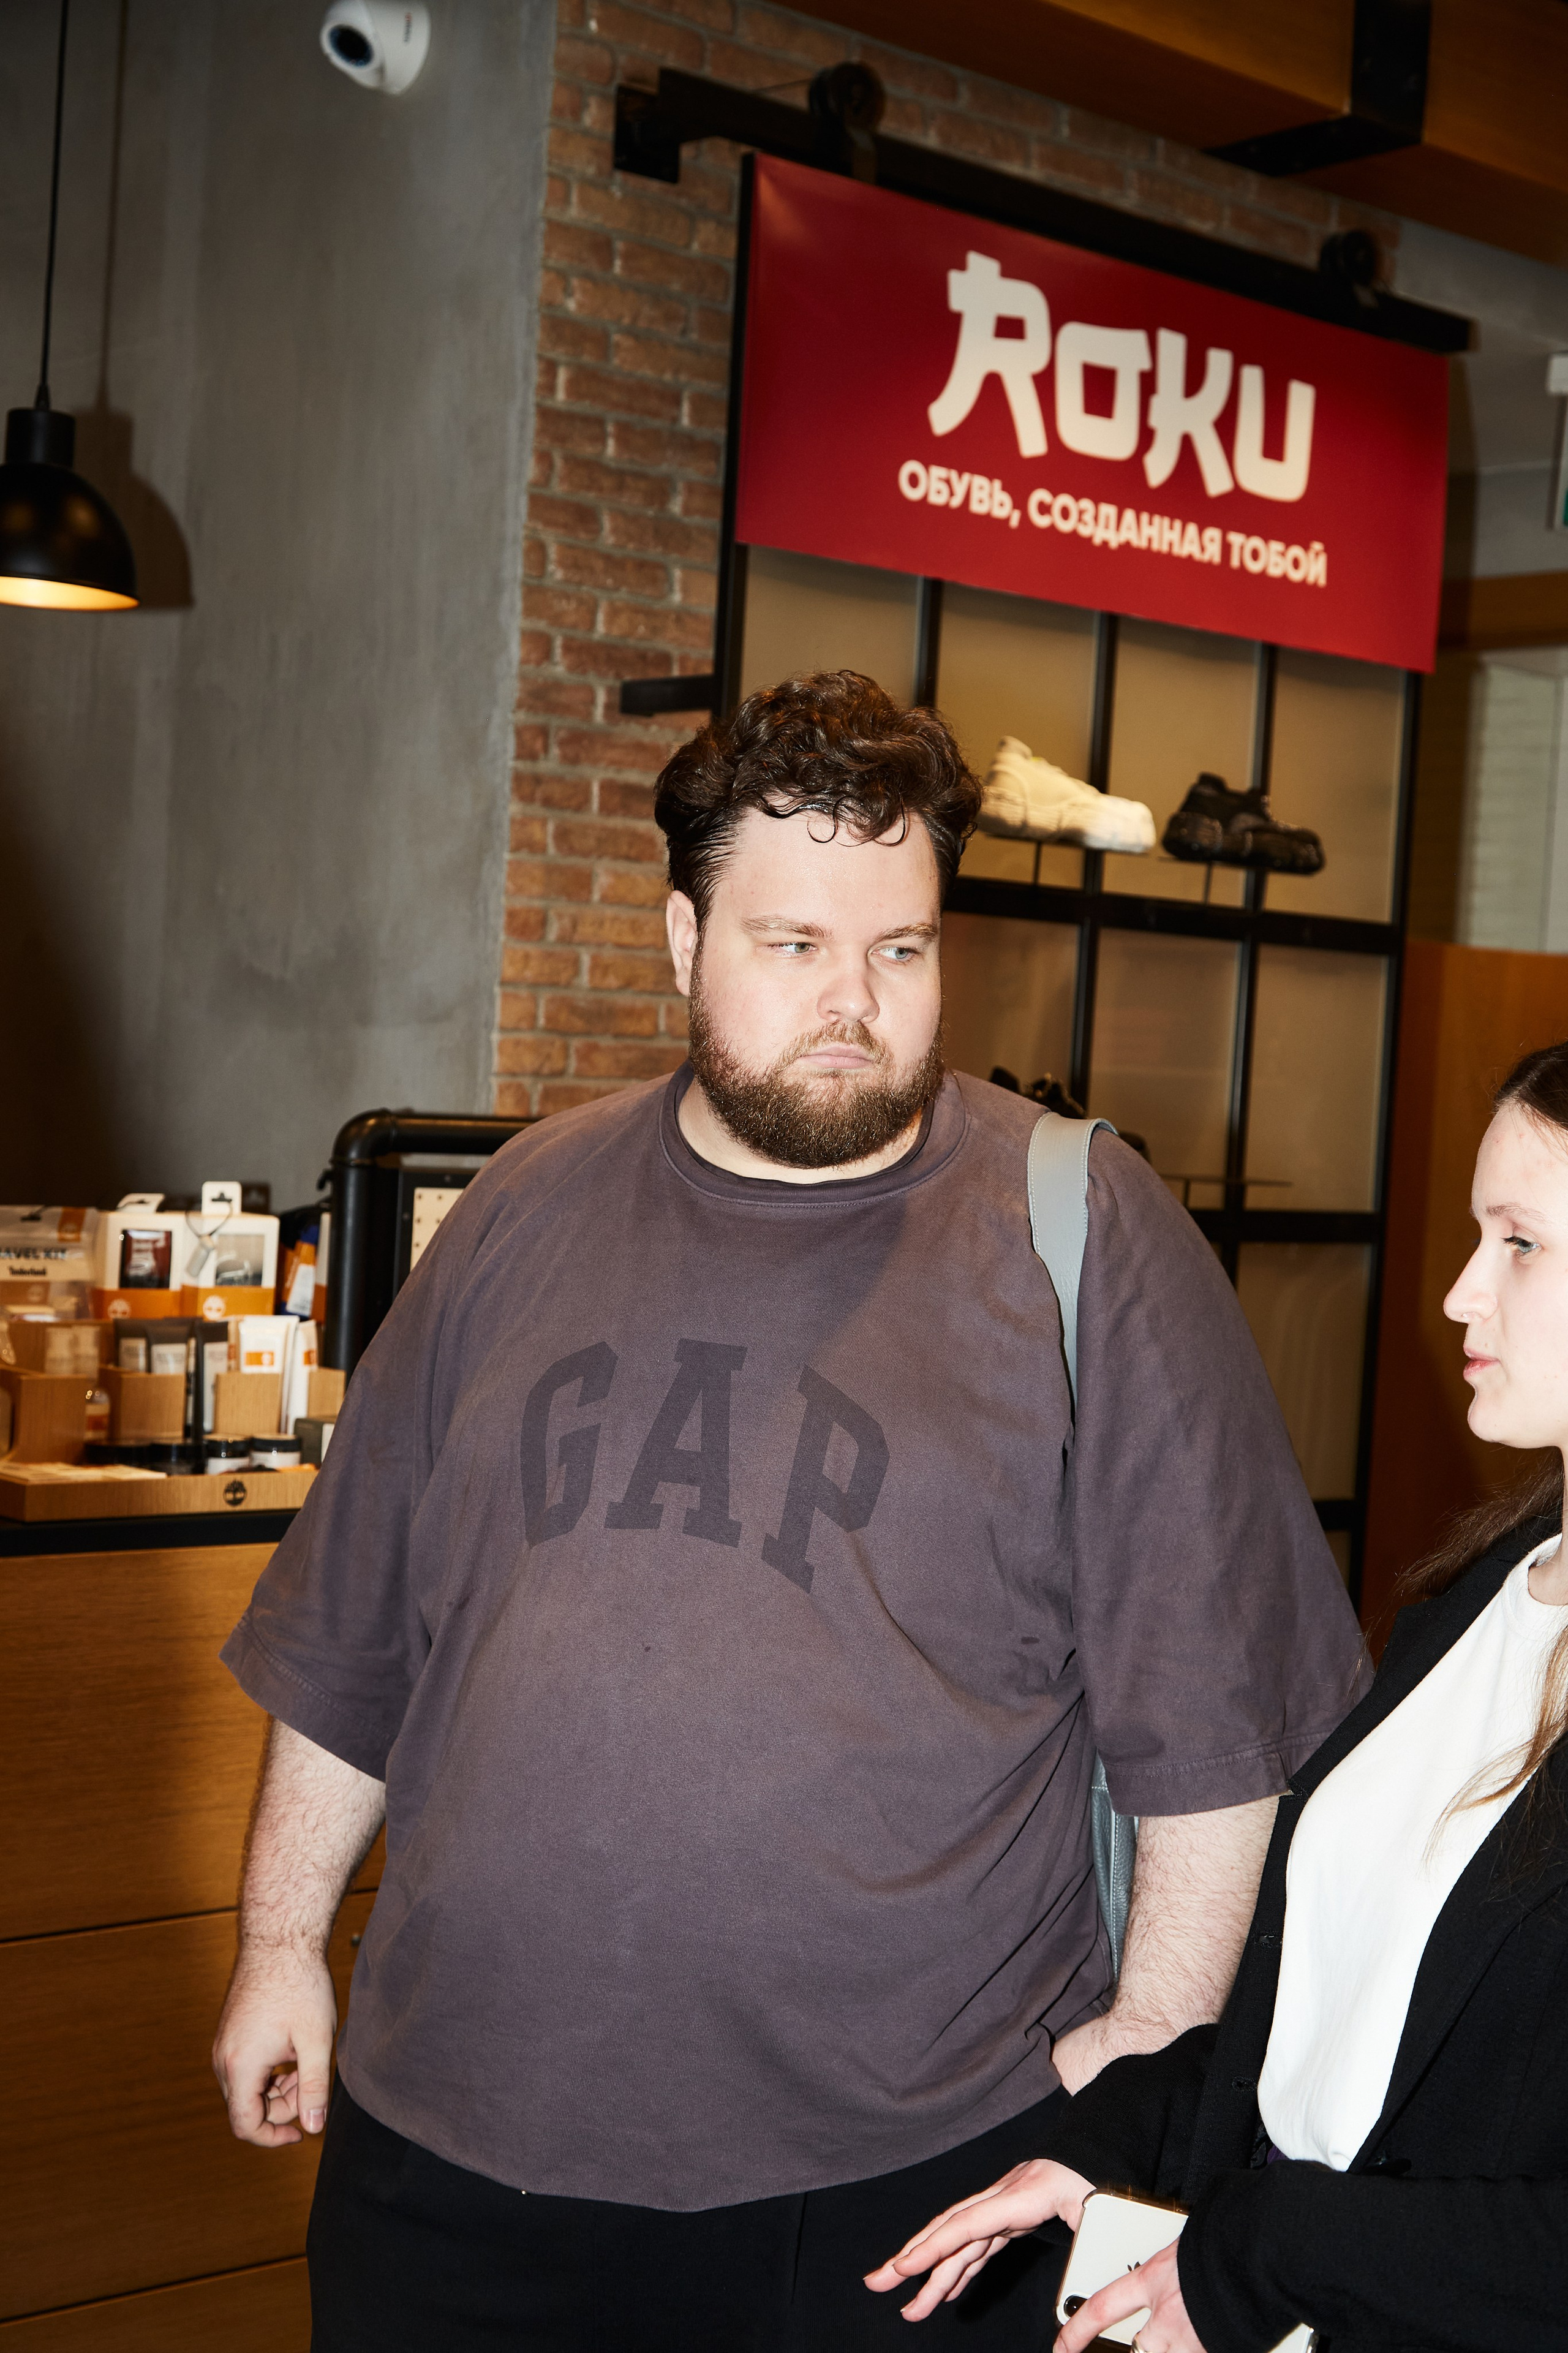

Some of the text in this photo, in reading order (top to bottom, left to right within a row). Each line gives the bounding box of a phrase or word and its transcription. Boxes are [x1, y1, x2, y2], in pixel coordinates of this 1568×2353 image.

[928, 251, 1315, 502] ROKU
[899, 460, 1327, 587] ОБУВЬ, СОЗДАННАЯ ТОБОЙ
[520, 1337, 889, 1593] GAP
